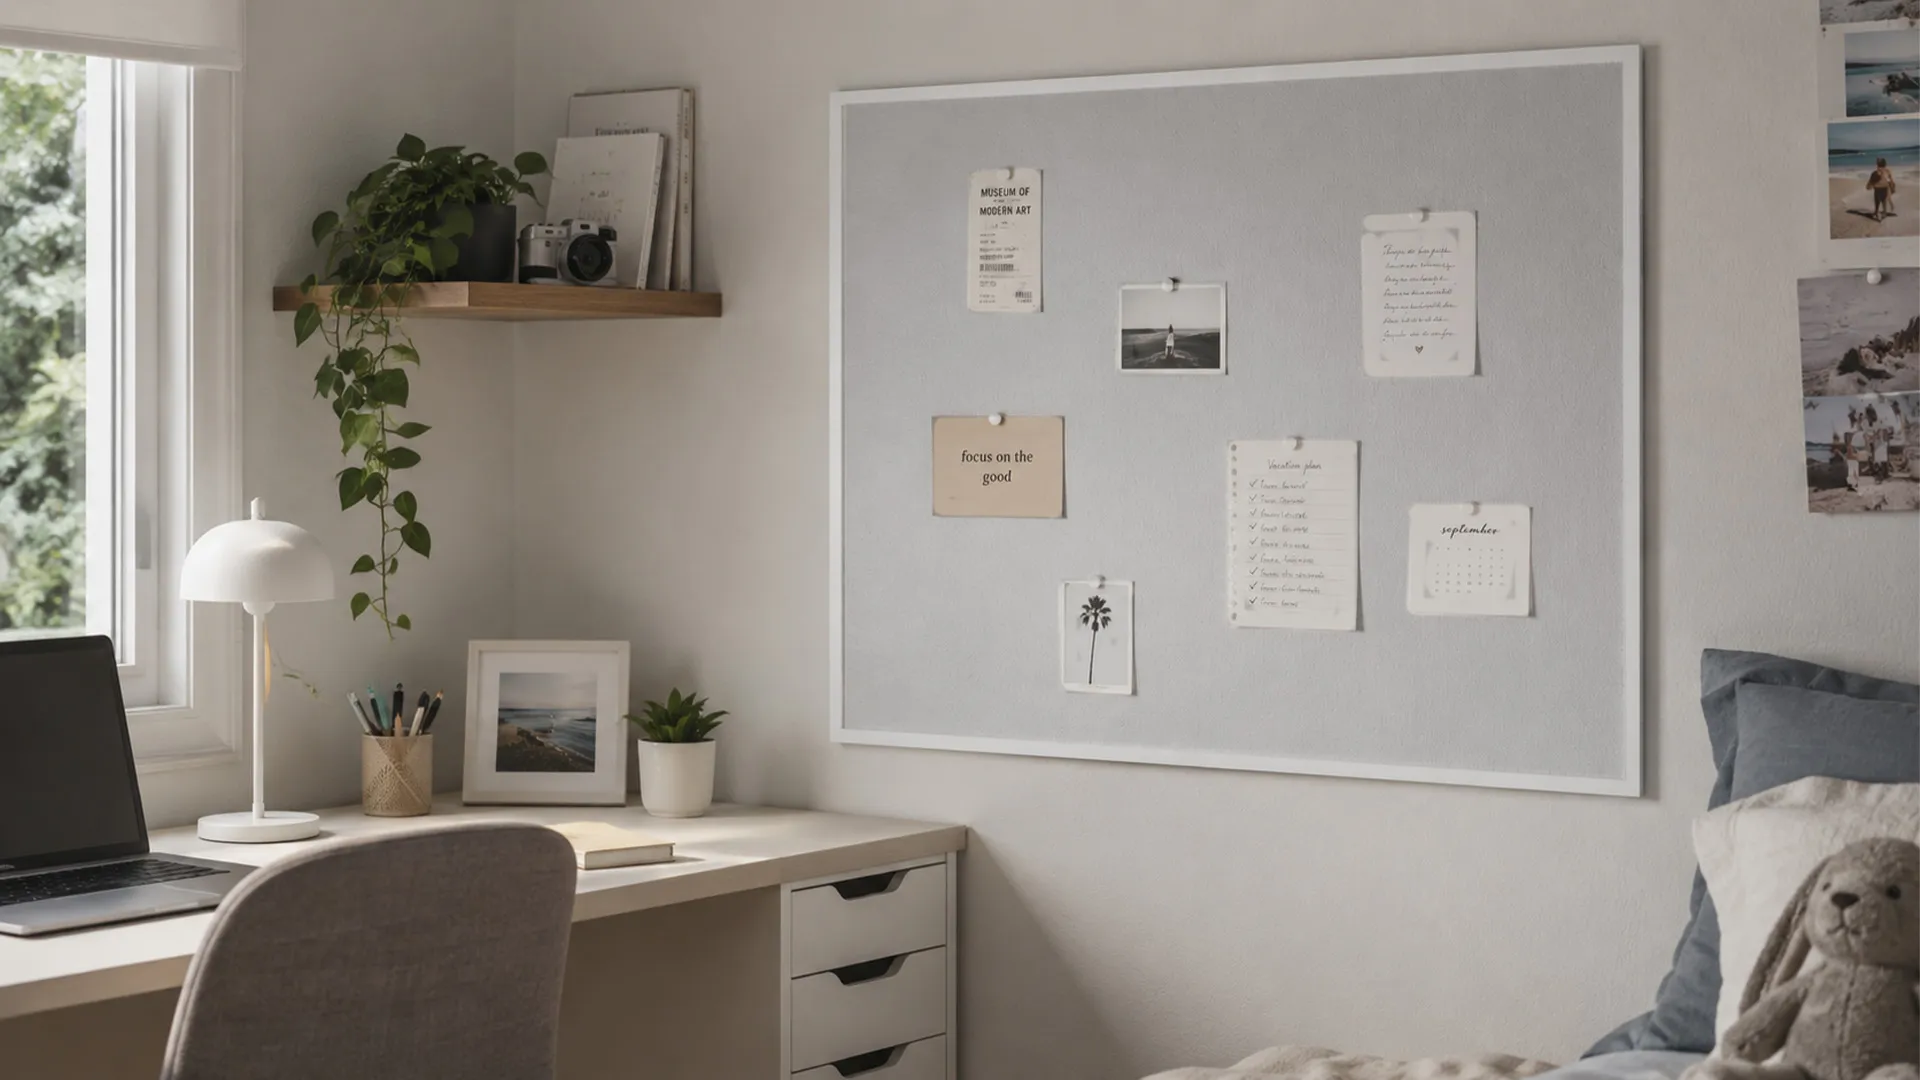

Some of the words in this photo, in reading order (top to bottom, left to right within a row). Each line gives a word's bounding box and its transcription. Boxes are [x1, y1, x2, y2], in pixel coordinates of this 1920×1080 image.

[981, 188, 1016, 198] MUSEUM
[1019, 187, 1030, 197] OF
[979, 206, 1013, 216] MODERN
[1016, 205, 1031, 215] ART
[961, 449, 993, 463] focus
[996, 453, 1011, 463] on
[1015, 450, 1034, 463] the
[1303, 459, 1322, 475] plan
[982, 470, 1012, 486] good
[1441, 523, 1499, 539] september
